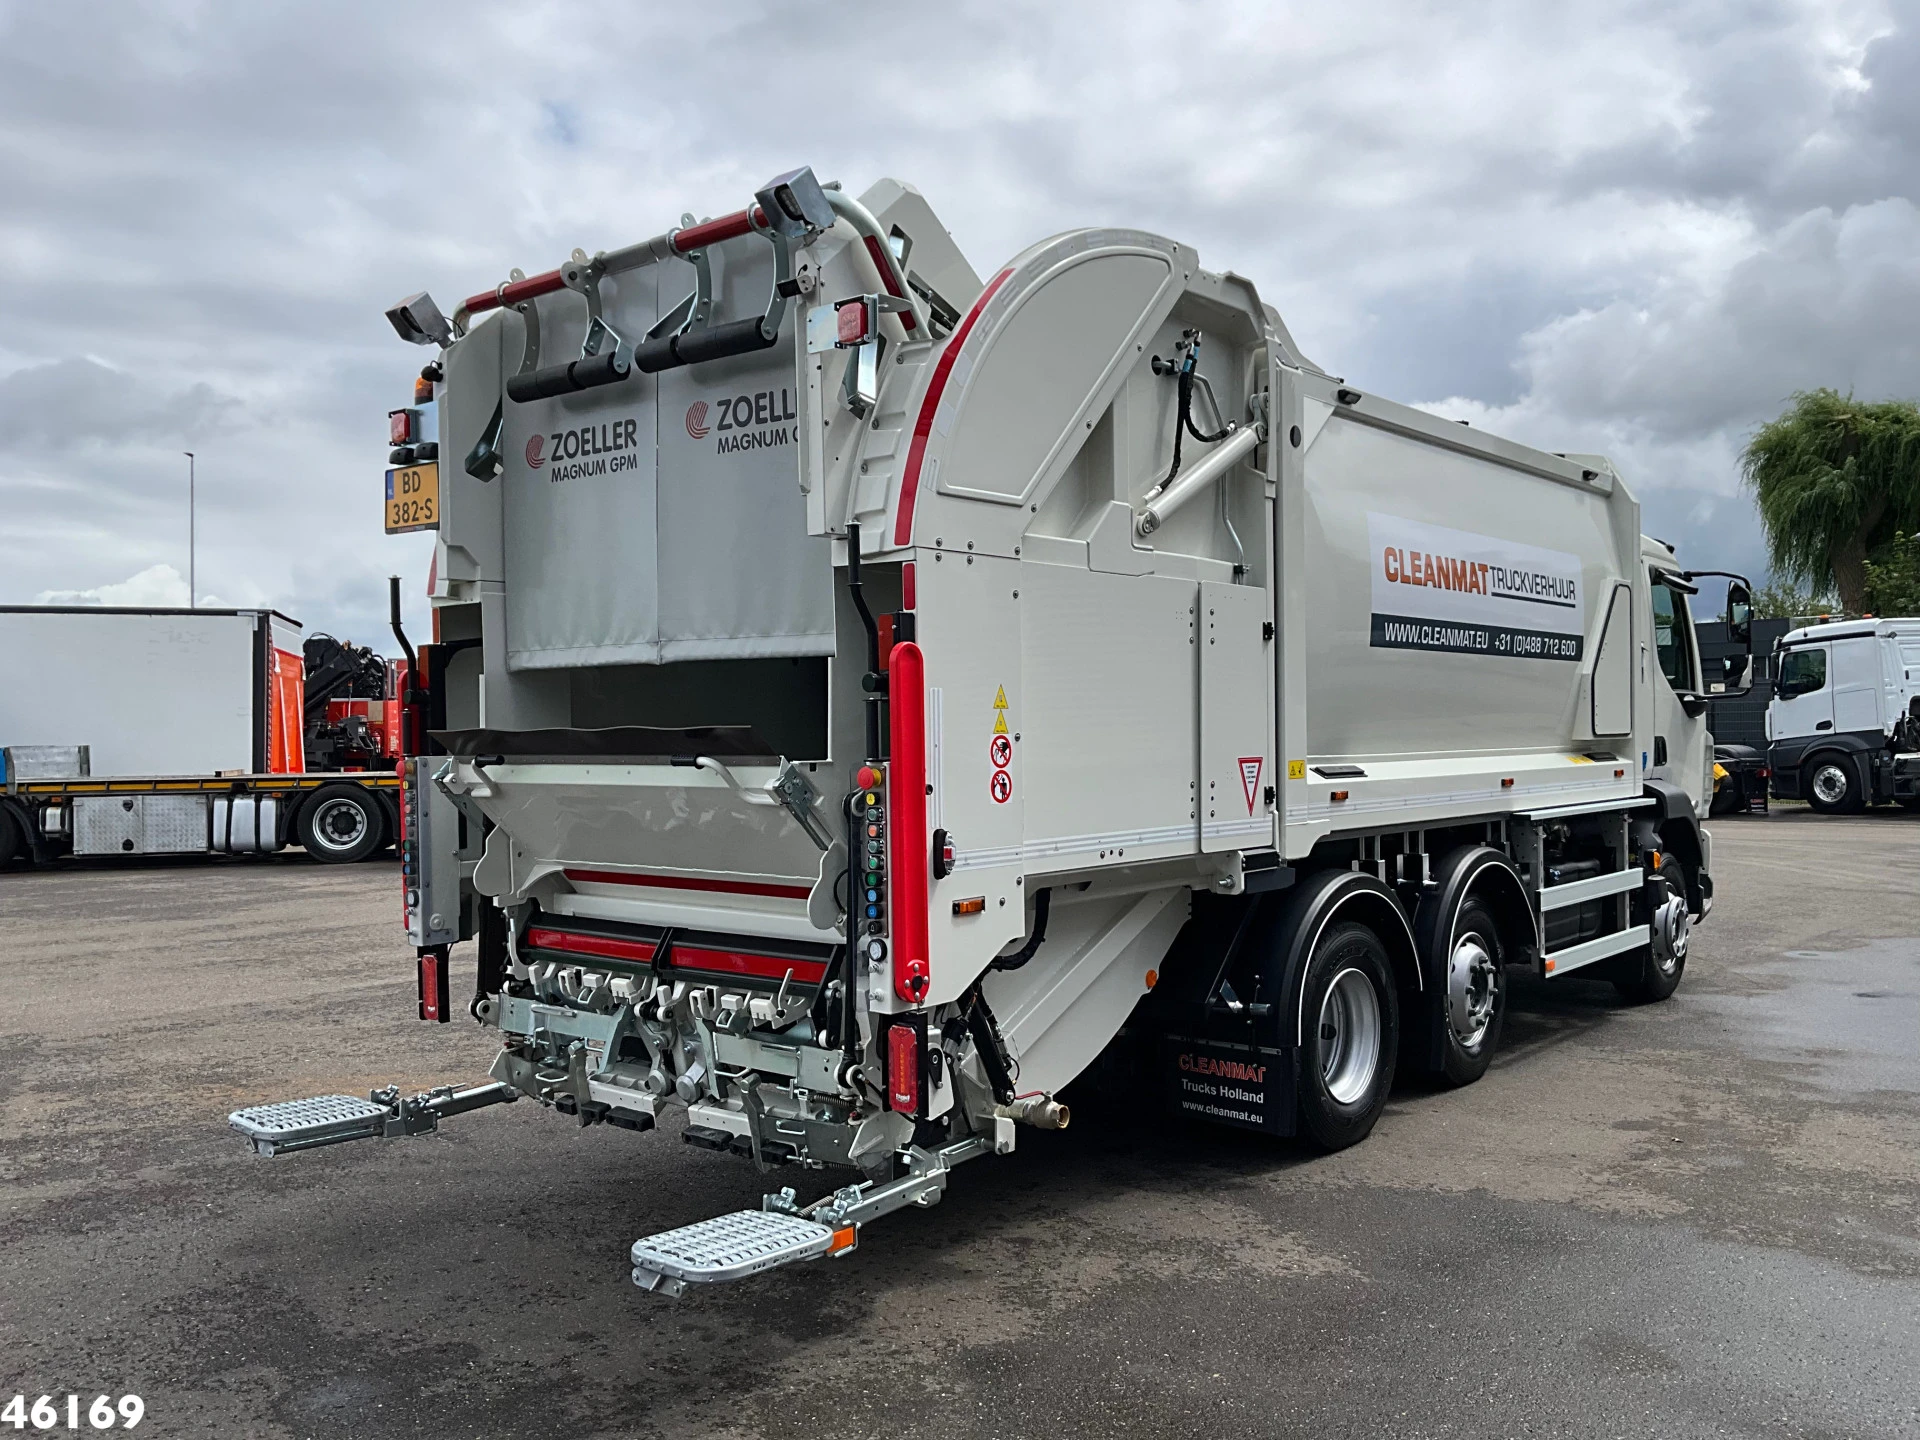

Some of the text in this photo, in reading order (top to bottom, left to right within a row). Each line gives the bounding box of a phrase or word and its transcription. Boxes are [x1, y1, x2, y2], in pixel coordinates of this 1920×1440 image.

[717, 388, 797, 431] ZOELL
[551, 419, 637, 462] ZOELLER
[717, 427, 788, 454] MAGNUM
[402, 470, 421, 494] BD
[551, 453, 638, 483] MAGNUM GPM
[392, 498, 433, 525] 382-S
[1384, 546, 1576, 601] CLEANMAT TRUCKVERHUUR
[1384, 622, 1576, 656] WWW.CLEANMAT.EU +31 (0)488 712 600
[1179, 1054, 1266, 1082] CLEANMAT
[1181, 1078, 1264, 1104] Trucks Holland
[1182, 1100, 1263, 1124] www.cleanmat.eu
